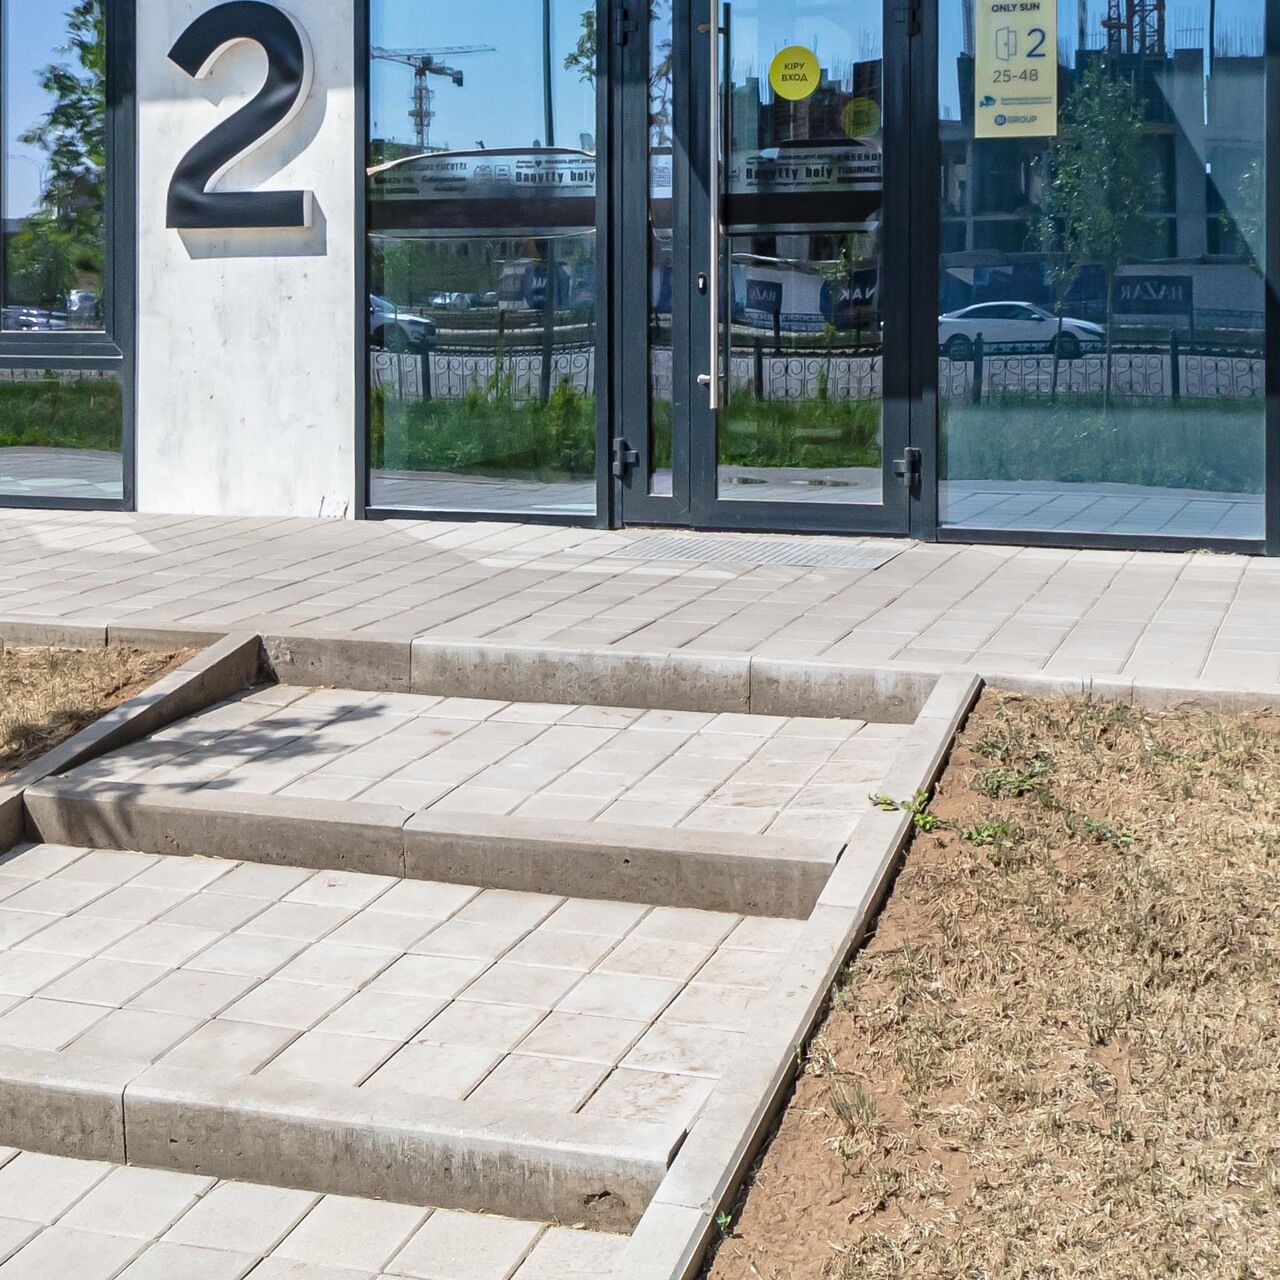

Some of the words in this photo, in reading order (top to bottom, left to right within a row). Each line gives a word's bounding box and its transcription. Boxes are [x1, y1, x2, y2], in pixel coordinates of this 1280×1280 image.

[991, 3, 1017, 13] ONLY
[1019, 2, 1040, 12] SUN
[1026, 28, 1046, 58] 2
[784, 62, 805, 71] КІРУ
[781, 73, 808, 82] ВХОД
[992, 68, 1039, 84] 25-48
[166, 0, 313, 229] 2
[1008, 115, 1038, 124] GROUP
